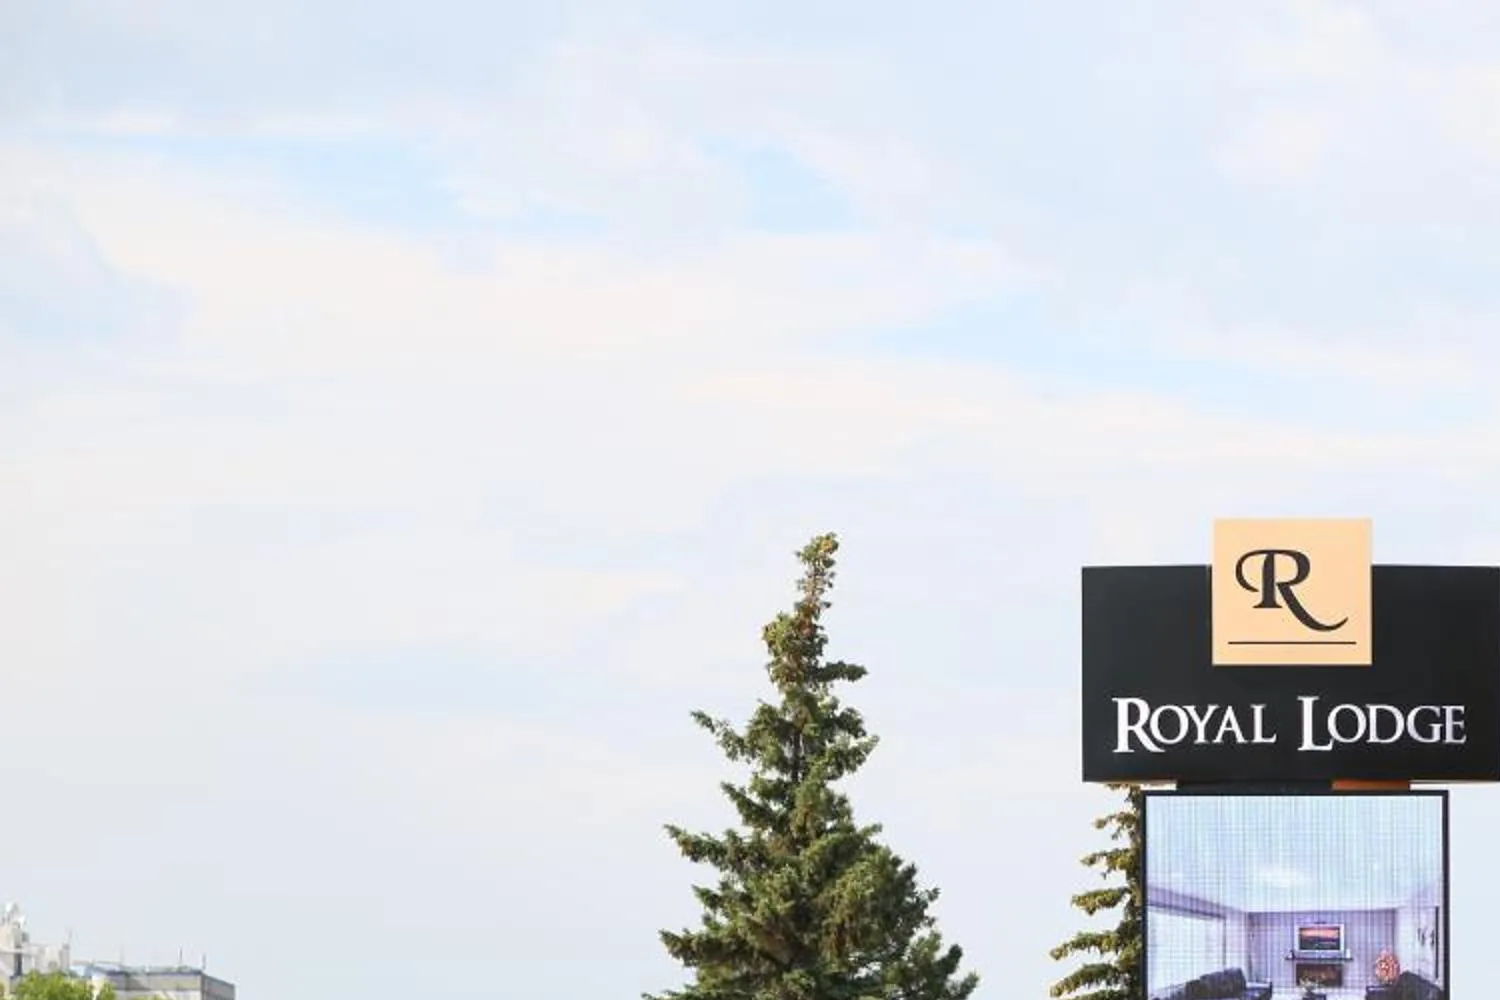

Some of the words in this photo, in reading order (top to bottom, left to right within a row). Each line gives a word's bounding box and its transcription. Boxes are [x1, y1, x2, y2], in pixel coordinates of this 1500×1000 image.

[1234, 548, 1349, 632] R
[1112, 697, 1277, 753] ROYAL
[1298, 695, 1467, 751] LODGE
